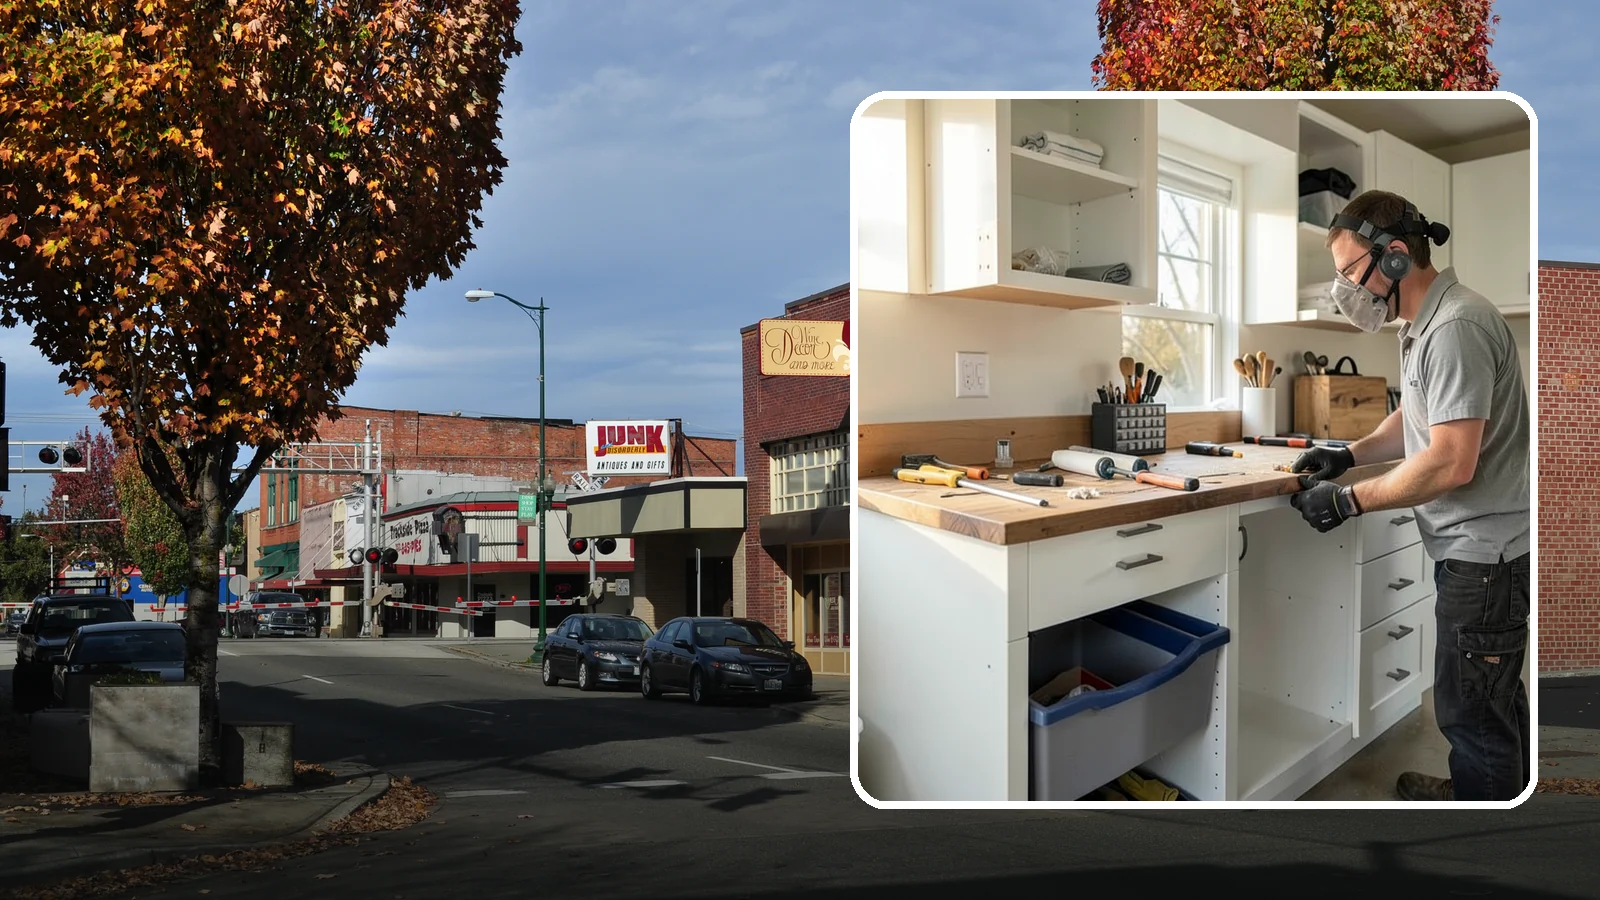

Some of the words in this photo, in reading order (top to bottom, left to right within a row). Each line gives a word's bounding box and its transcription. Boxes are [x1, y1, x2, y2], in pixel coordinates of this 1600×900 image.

[596, 425, 665, 457] JUNK
[607, 446, 646, 454] DISORDERLY
[597, 461, 628, 470] ANTIQUES
[631, 461, 643, 469] AND
[647, 460, 665, 469] GIFTS
[573, 473, 589, 490] RAIL
